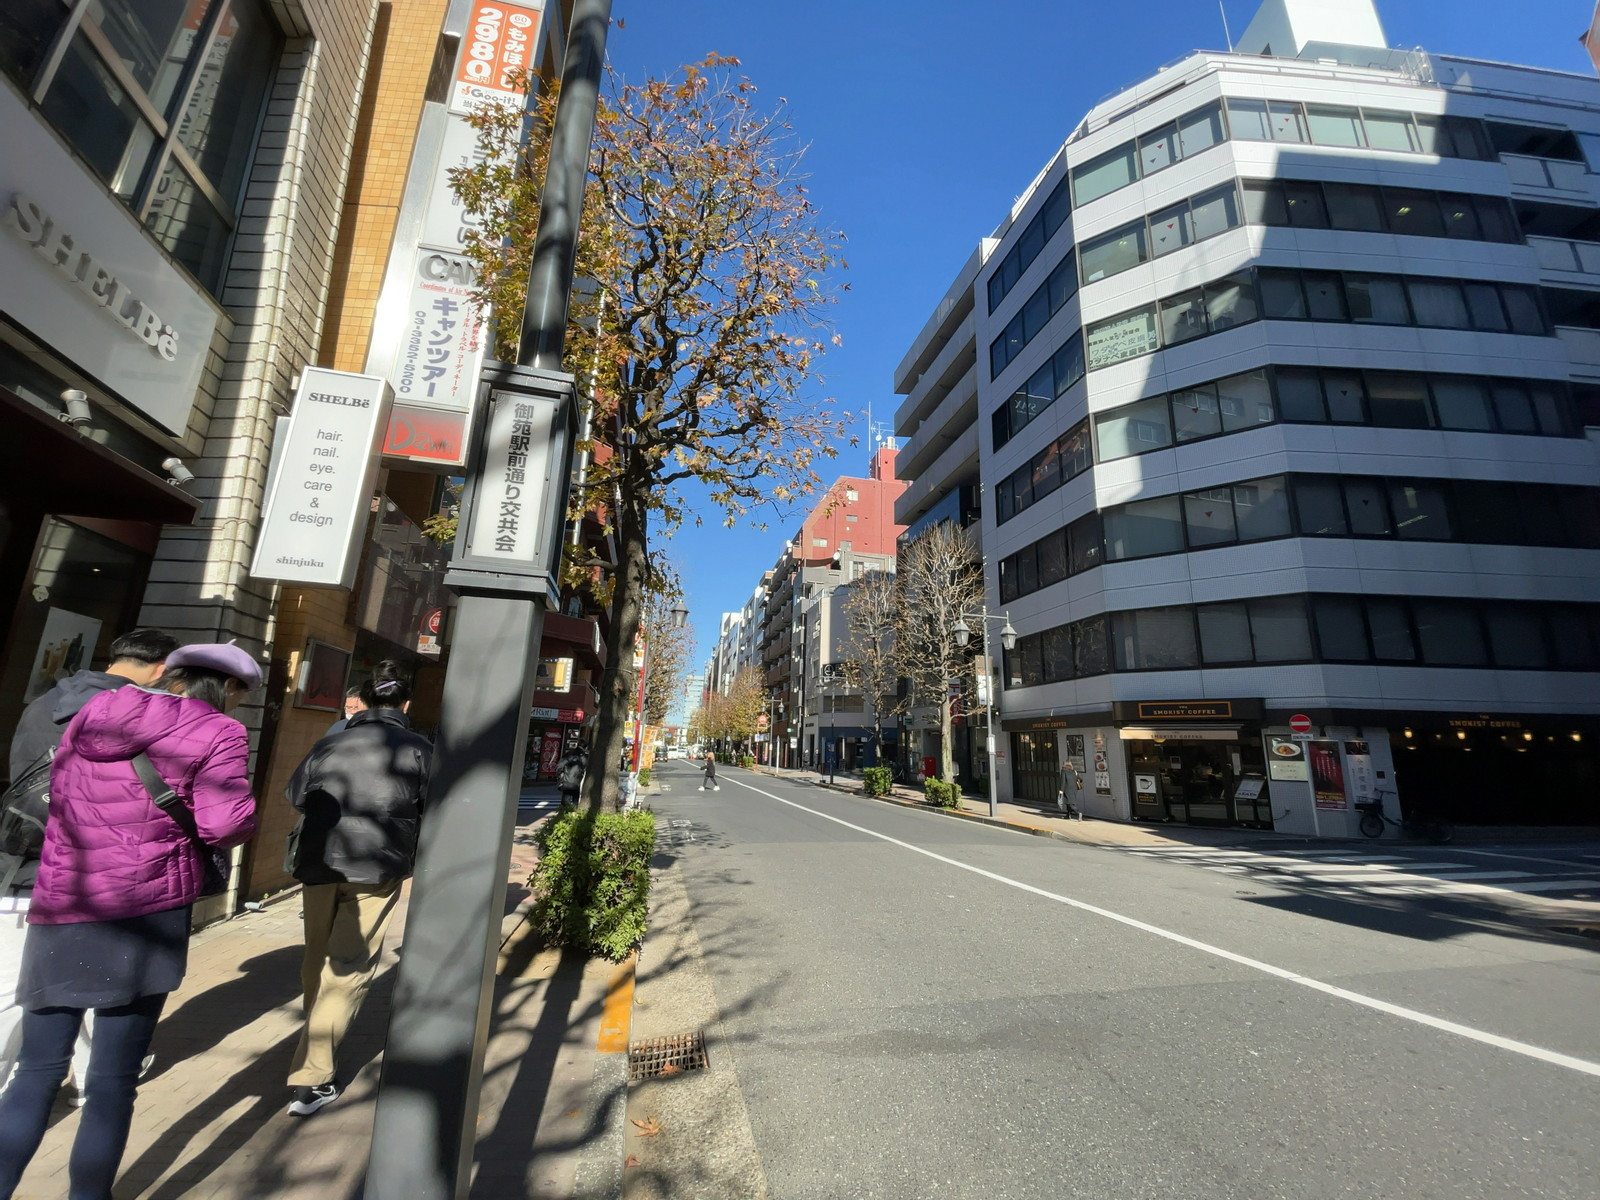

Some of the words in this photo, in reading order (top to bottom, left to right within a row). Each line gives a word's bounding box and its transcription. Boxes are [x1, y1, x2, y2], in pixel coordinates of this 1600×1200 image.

[4, 192, 179, 361] SHELBë
[399, 310, 427, 393] 03-3352-5200
[421, 297, 459, 398] キャンツアー
[308, 392, 370, 408] SHELBë
[317, 429, 343, 442] hair.
[313, 445, 339, 458] nail.
[309, 463, 336, 475] eye.
[495, 402, 534, 553] 御苑駅前通り交共会
[304, 479, 332, 492] care
[309, 497, 320, 508] &
[289, 511, 333, 527] design
[275, 556, 324, 568] shinjuku
